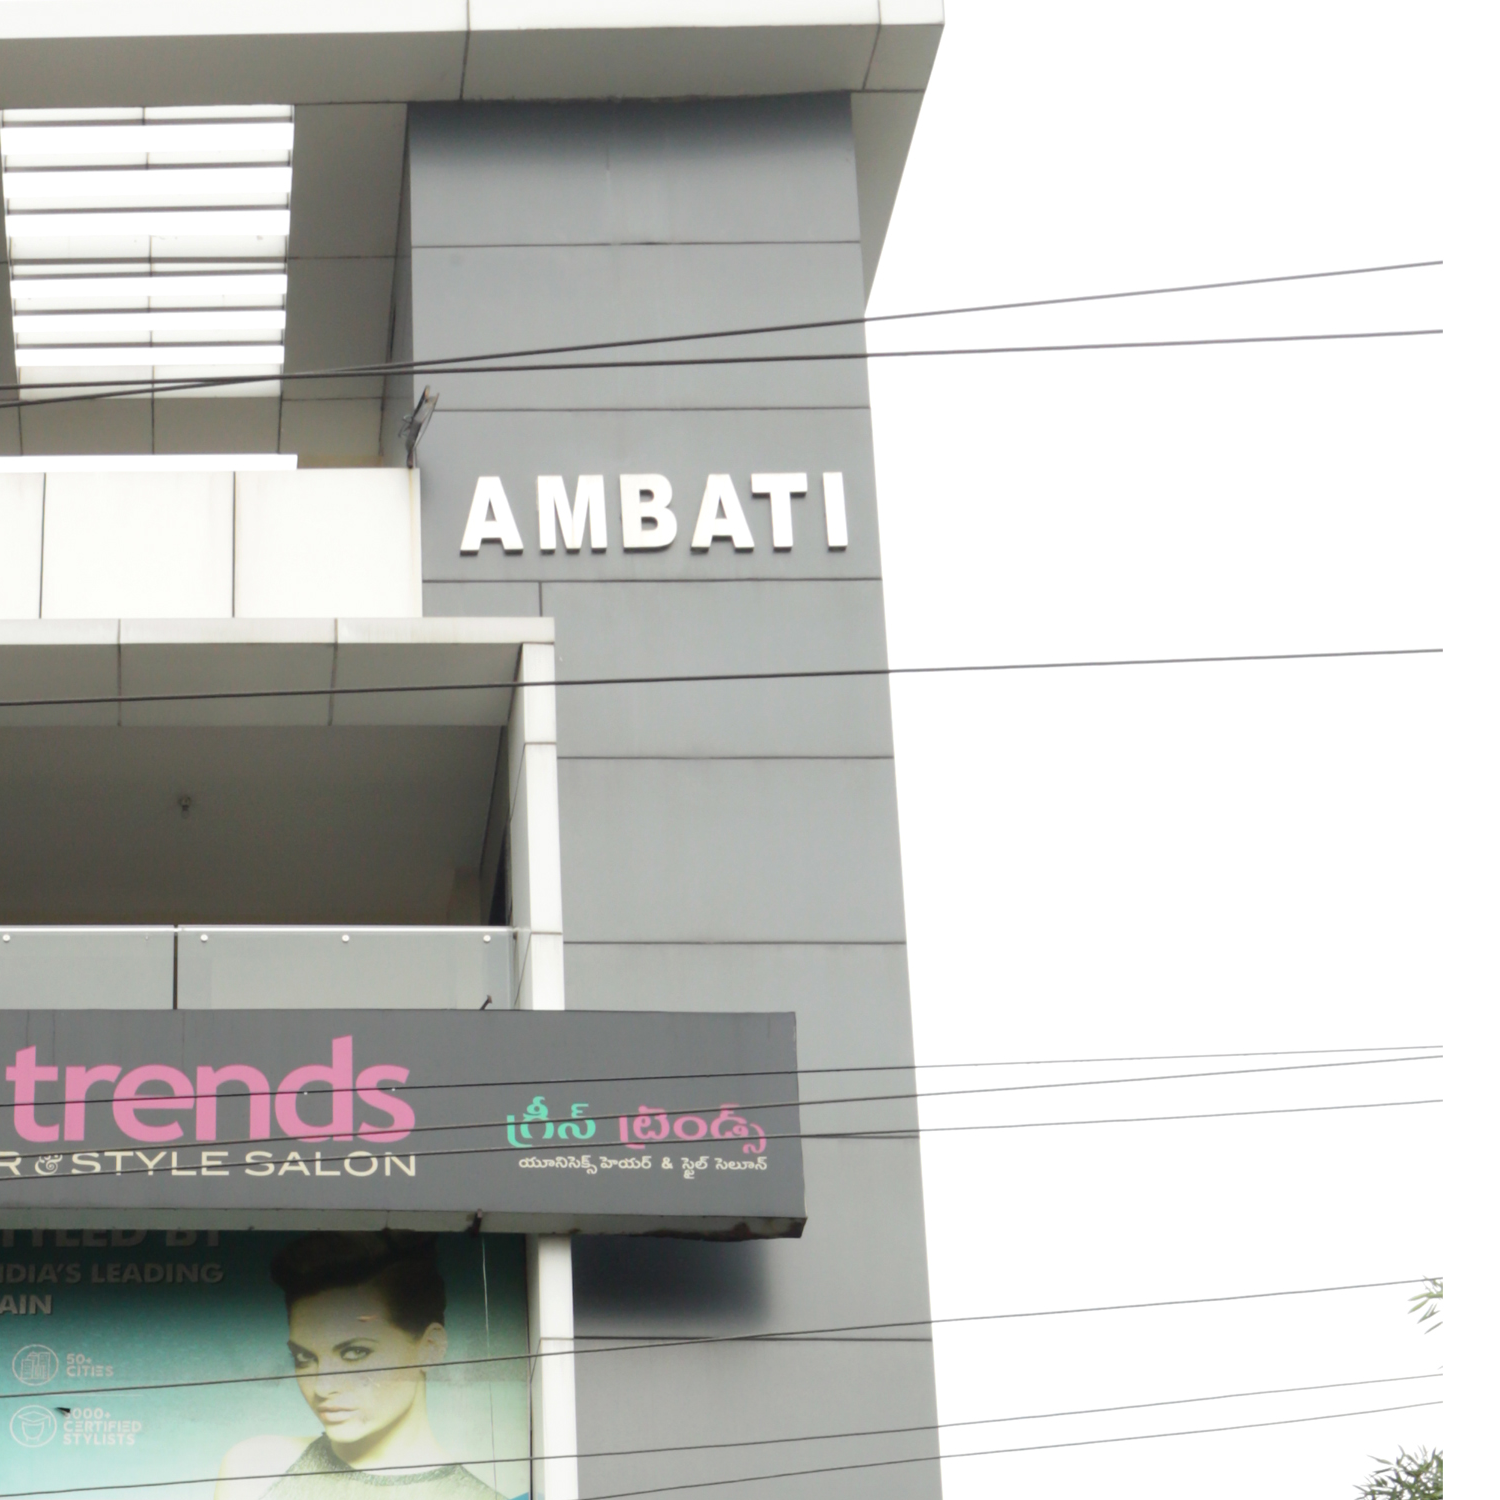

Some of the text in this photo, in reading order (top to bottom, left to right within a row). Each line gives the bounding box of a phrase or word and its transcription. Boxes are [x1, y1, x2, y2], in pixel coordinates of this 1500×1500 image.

[459, 471, 849, 556] AMBATI
[5, 1035, 416, 1144] trends
[70, 1149, 227, 1177] STYLE
[244, 1149, 417, 1177] SALON
[661, 1156, 674, 1171] &
[91, 1263, 224, 1284] LEADING
[66, 1354, 92, 1365] 50+
[66, 1366, 114, 1377] CITIES
[63, 1421, 142, 1433] CERTIFIED
[63, 1433, 135, 1446] STYLISTS
